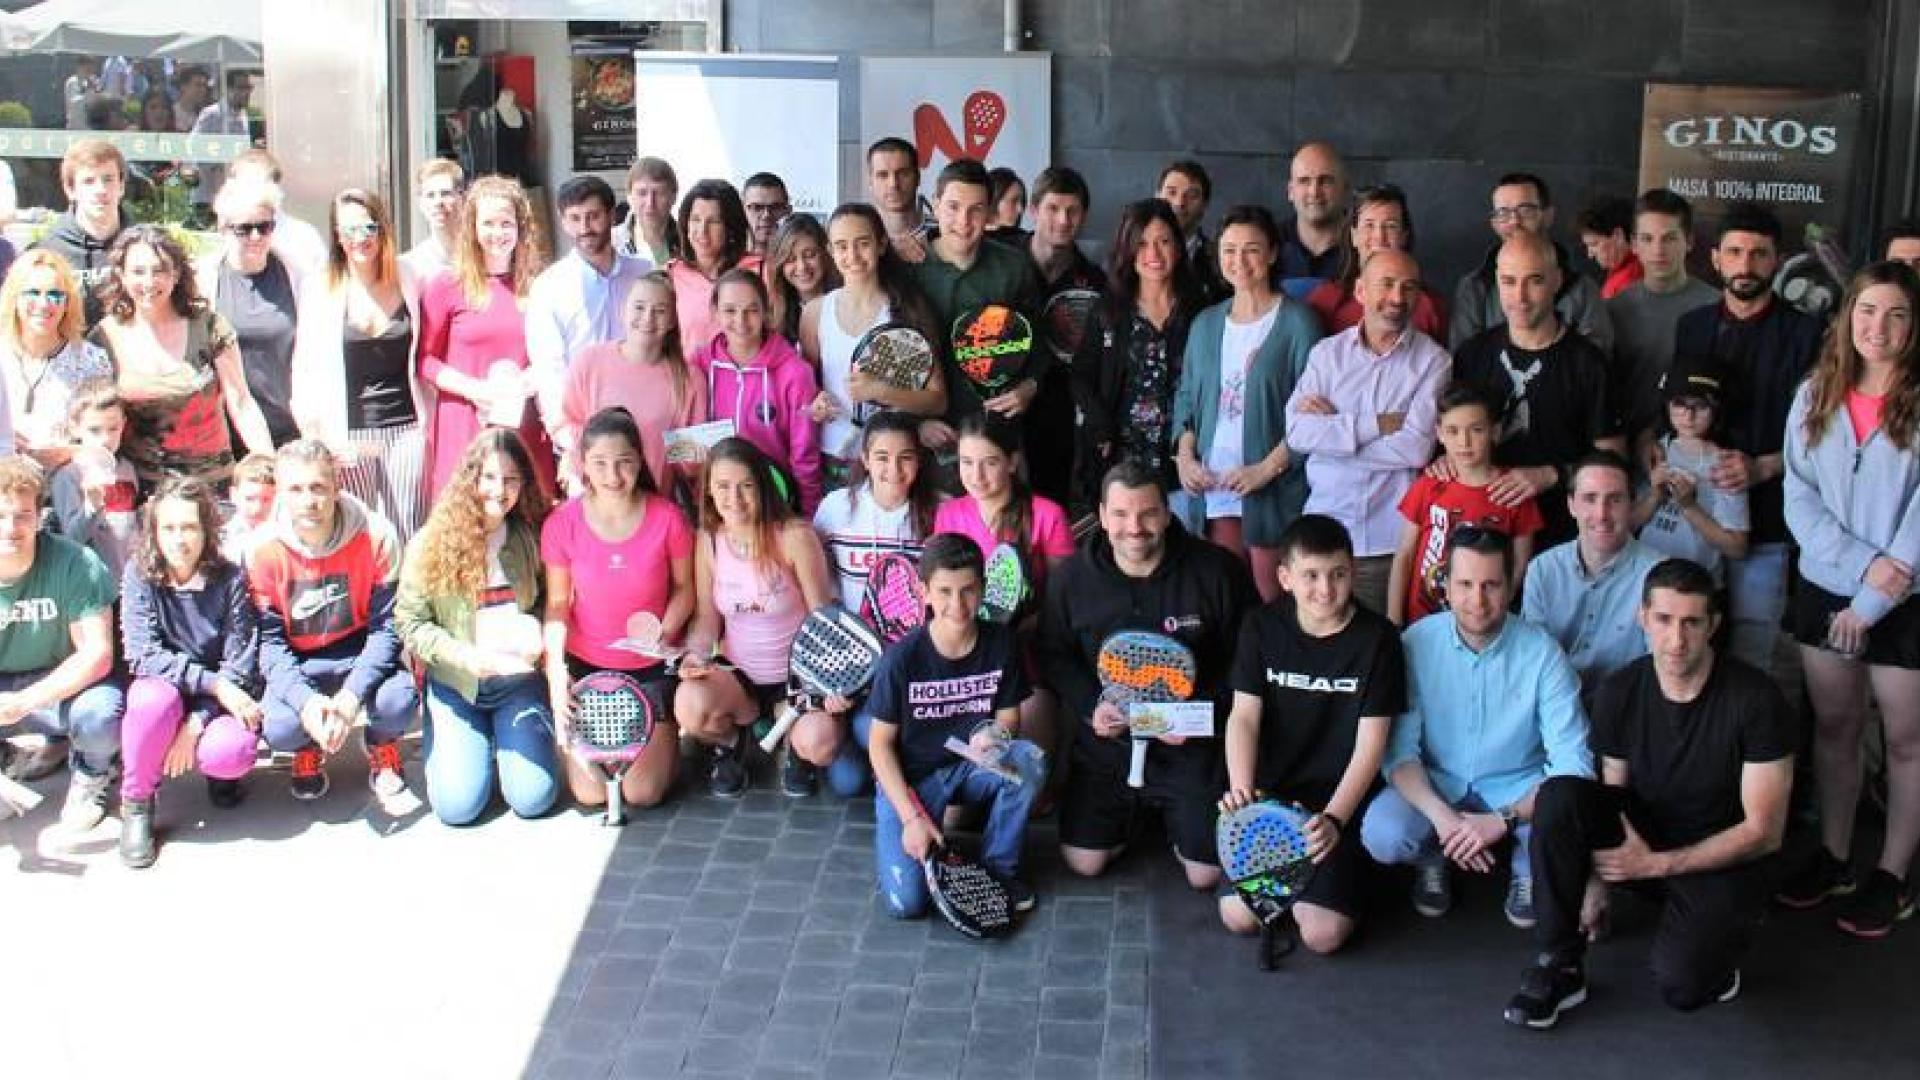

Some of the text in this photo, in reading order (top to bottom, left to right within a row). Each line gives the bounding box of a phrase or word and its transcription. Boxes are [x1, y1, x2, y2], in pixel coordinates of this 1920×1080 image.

[1664, 115, 1838, 154] GINOS
[1669, 176, 1825, 204] MASA 100% INTEGRAL
[1266, 667, 1359, 692] HEAD
[913, 697, 991, 720] CALIFORNI
